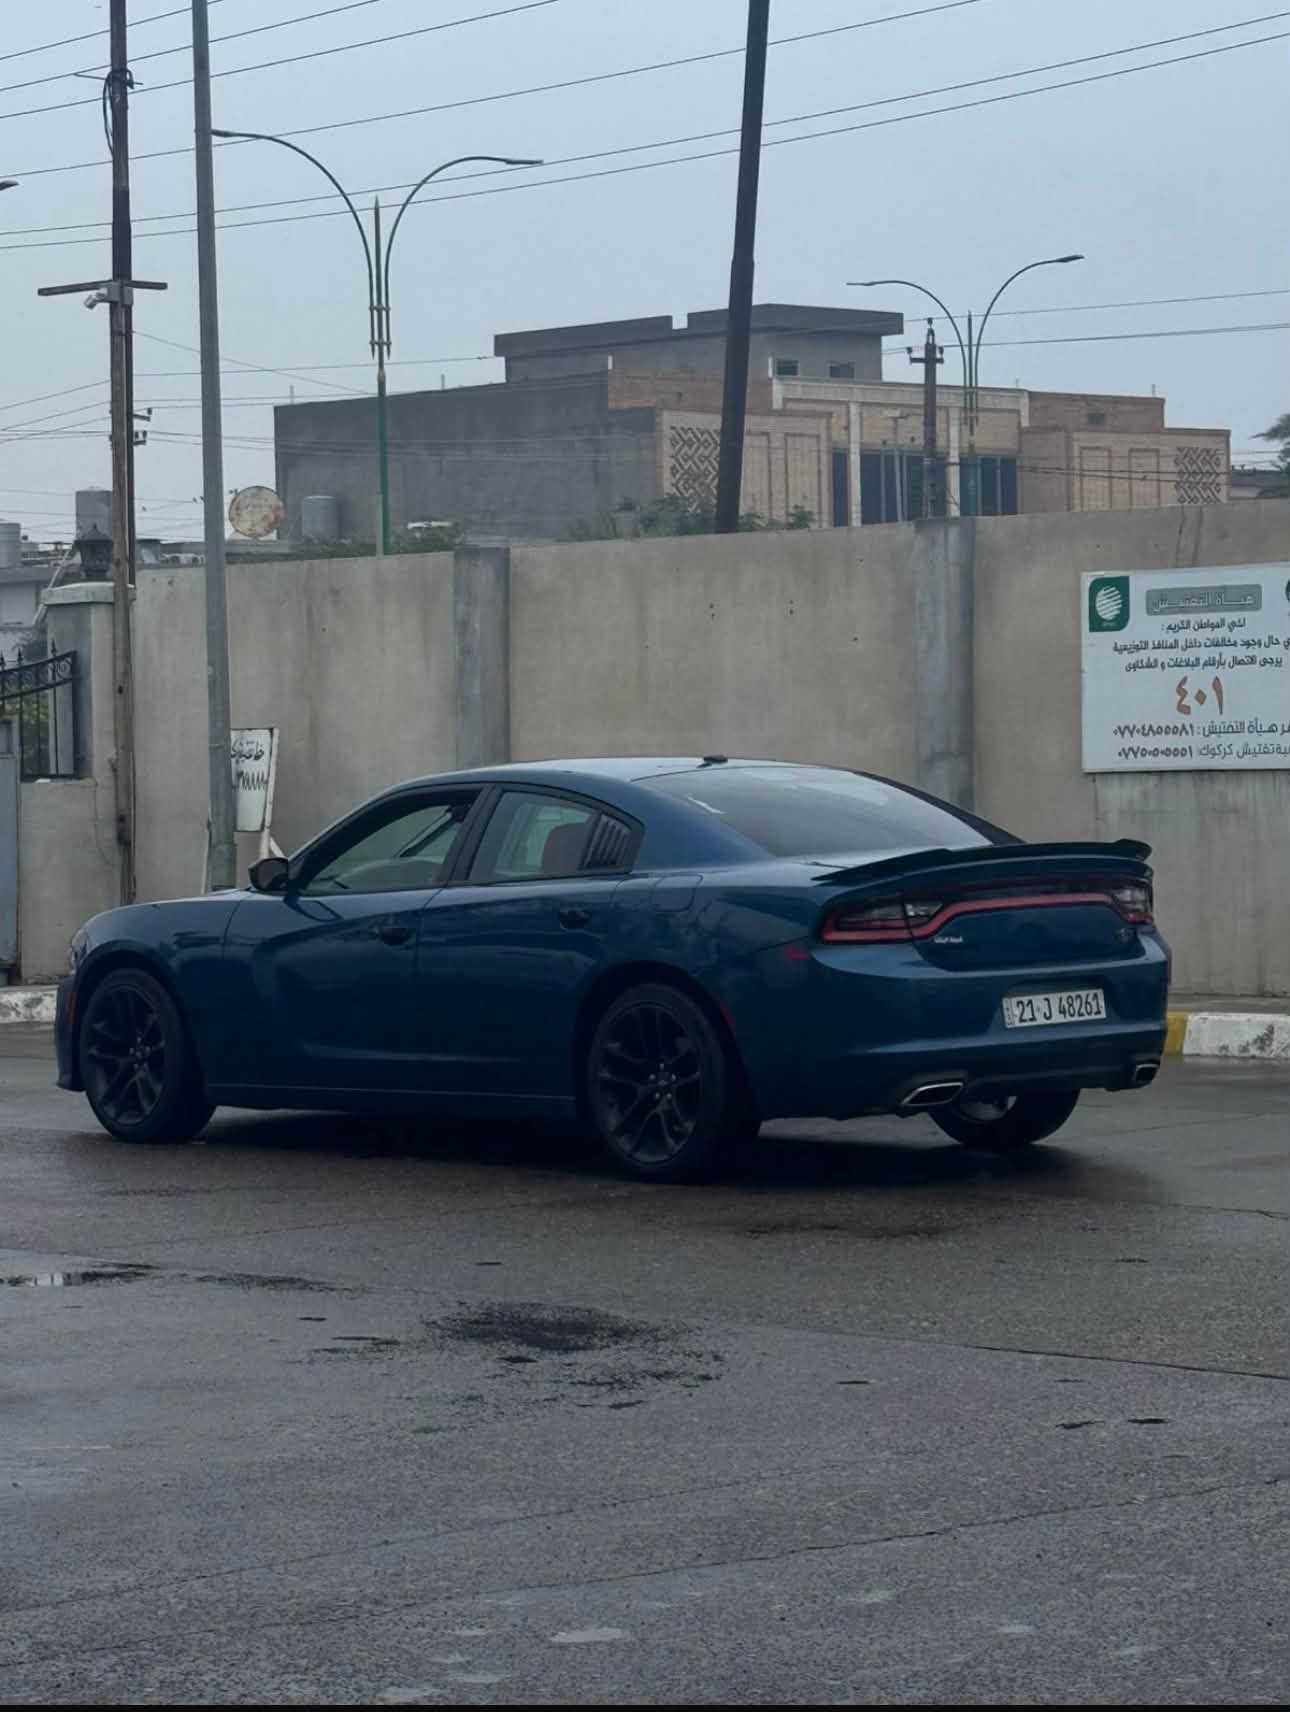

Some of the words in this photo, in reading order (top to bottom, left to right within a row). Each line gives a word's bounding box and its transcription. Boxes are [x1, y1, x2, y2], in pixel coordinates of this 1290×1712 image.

[1193, 617, 1225, 633] المواطن
[1151, 638, 1179, 651] المنافذ
[1181, 637, 1202, 651] داخل
[1204, 636, 1237, 649] مخالفات
[1240, 637, 1262, 650] وجود
[1264, 634, 1280, 649] حال
[1160, 660, 1166, 672] و
[1167, 656, 1200, 671] البلاغات
[1202, 652, 1226, 670] بأرقام
[1228, 654, 1257, 669] الاتصال
[1259, 656, 1283, 669] يرجى
[1176, 675, 1224, 716] ٤٠١
[1236, 742, 1275, 759] تفتيش
[1016, 999, 1037, 1023] 21
[1043, 997, 1053, 1021] J
[1058, 991, 1102, 1020] 48261
